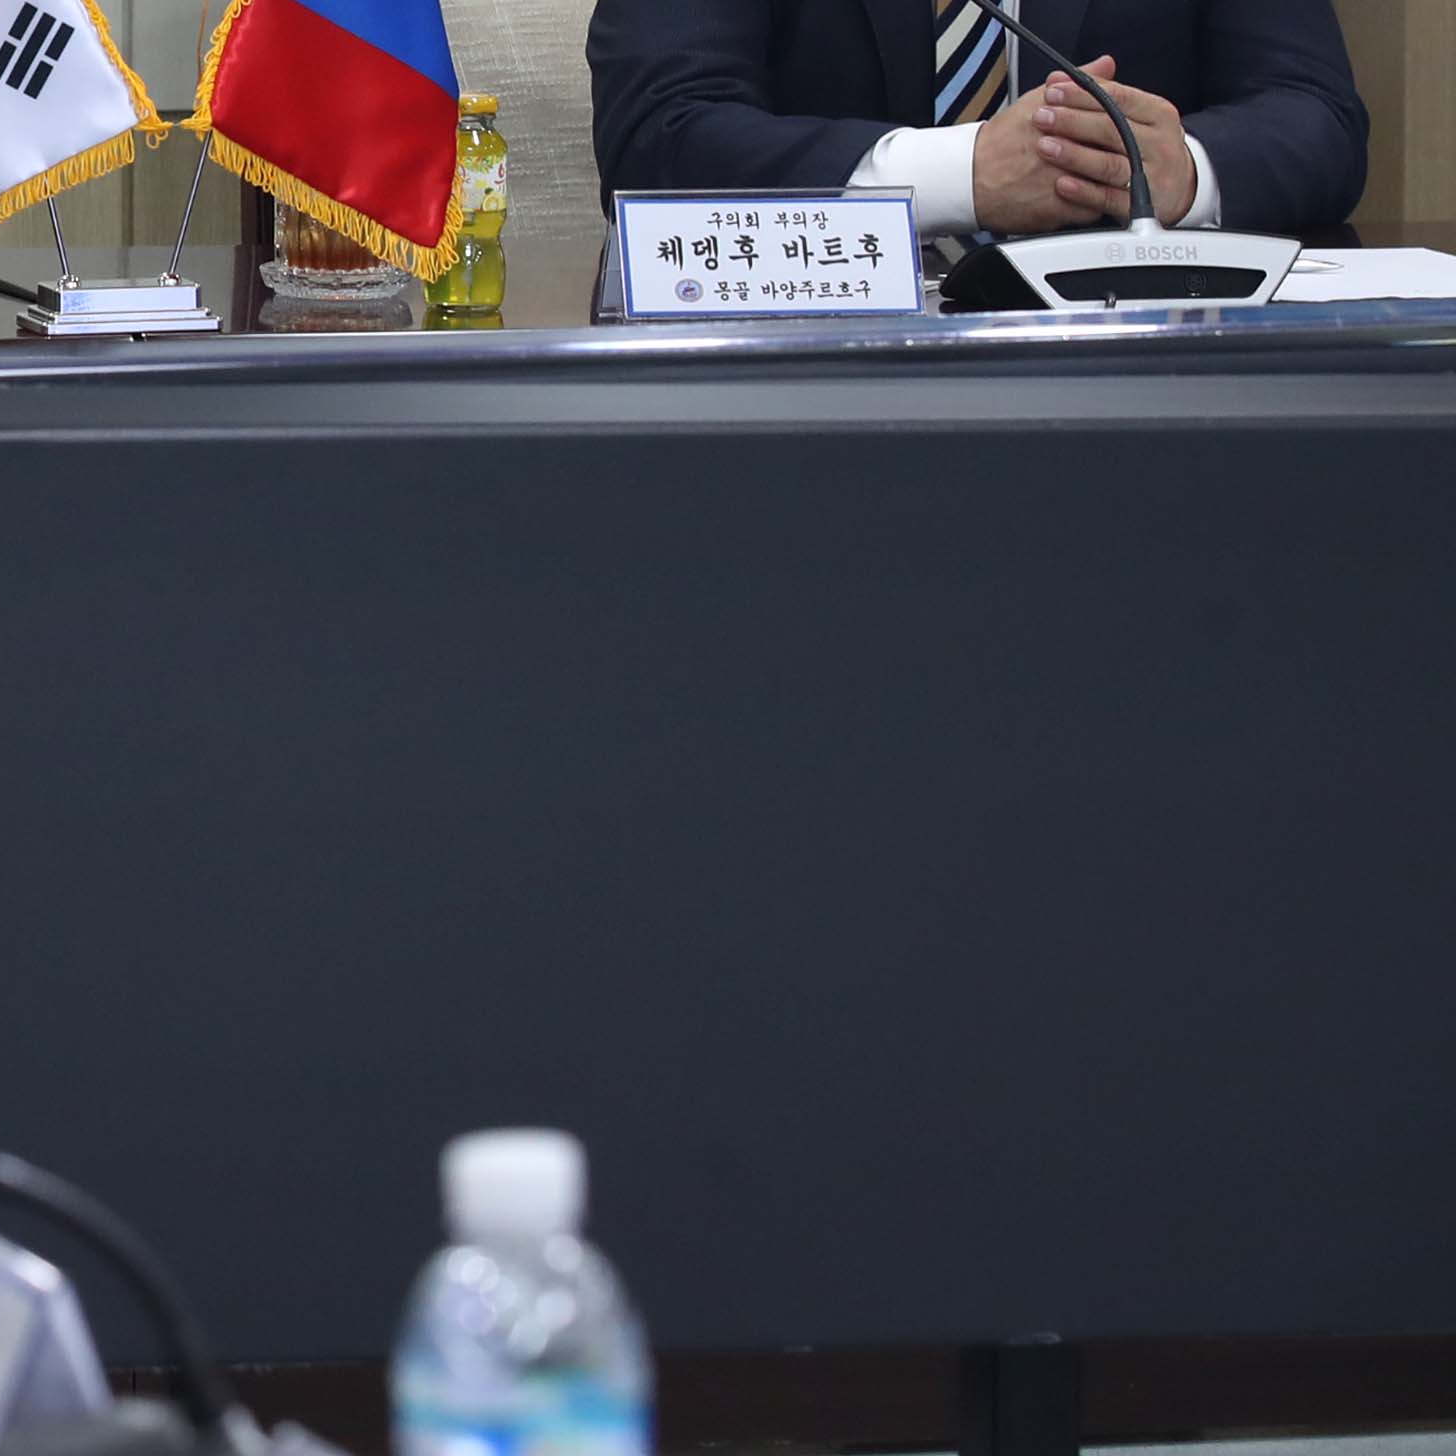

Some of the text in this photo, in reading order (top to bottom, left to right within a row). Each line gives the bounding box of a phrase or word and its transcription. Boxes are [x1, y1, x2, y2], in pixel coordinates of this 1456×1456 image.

[707, 211, 829, 231] 구의회 부의장
[657, 233, 884, 271] 체뎅후 바트후
[1134, 245, 1198, 261] BOSCH
[713, 280, 872, 302] 몽골 바양주르흐구
